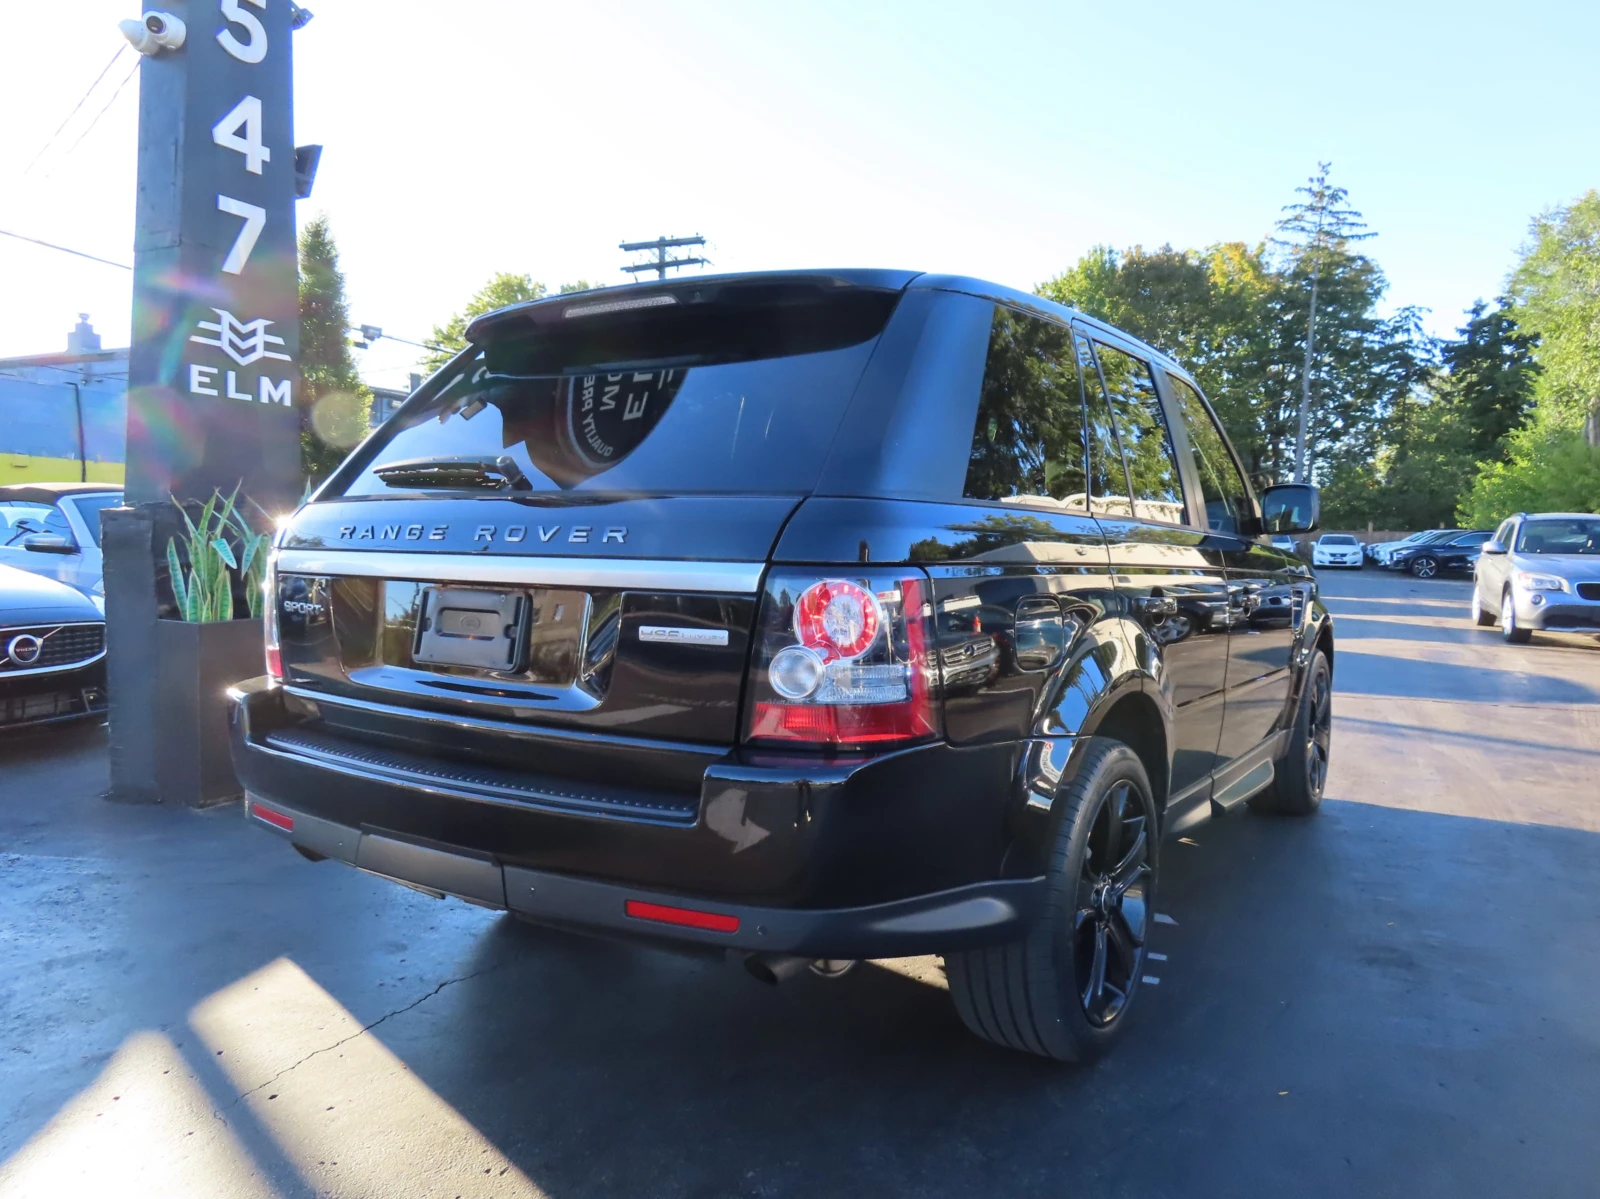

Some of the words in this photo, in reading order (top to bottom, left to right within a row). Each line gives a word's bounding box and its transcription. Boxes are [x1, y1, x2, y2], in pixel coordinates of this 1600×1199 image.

[189, 363, 292, 407] ELM
[340, 524, 449, 540] RANGE
[474, 525, 629, 543] ROVER
[283, 600, 322, 615] SPORT
